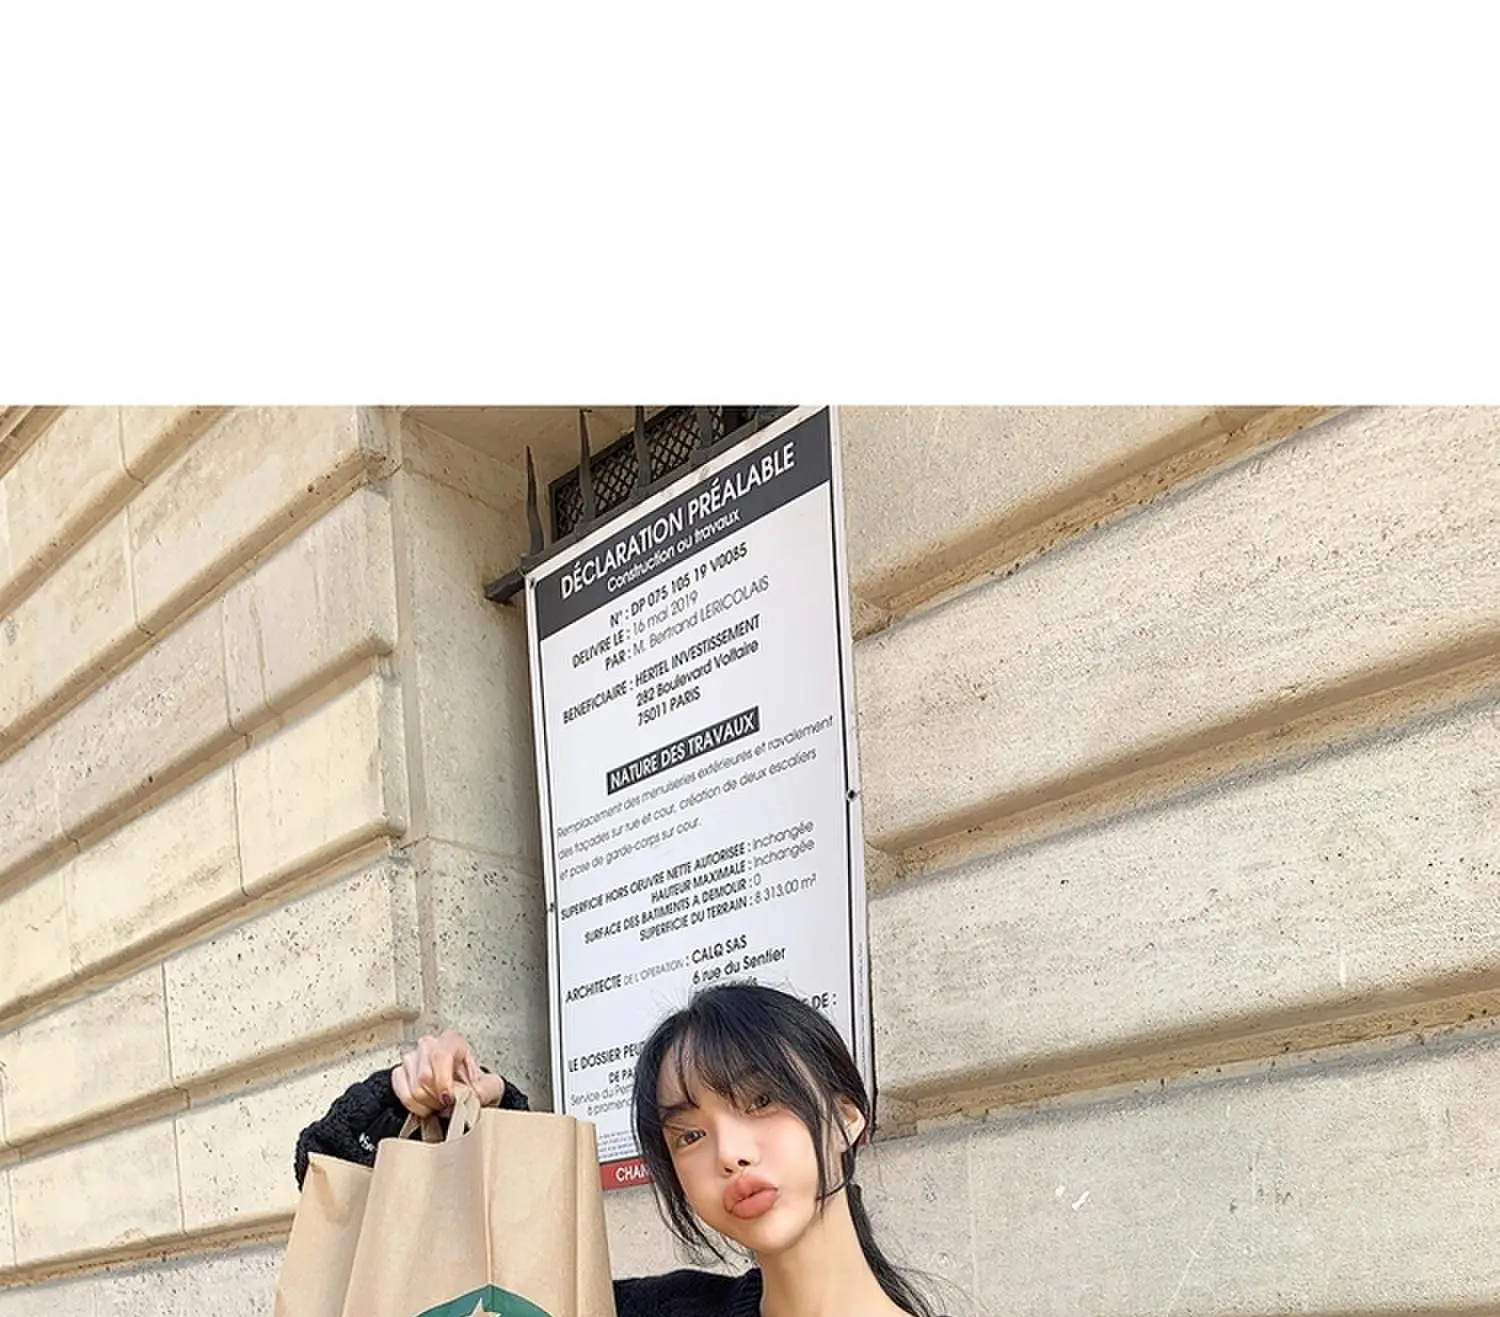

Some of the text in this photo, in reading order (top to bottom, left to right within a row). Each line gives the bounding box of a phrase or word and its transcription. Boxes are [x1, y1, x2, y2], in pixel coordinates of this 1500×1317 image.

[561, 439, 795, 600] DÉCLARATION PRÉALABLE
[606, 508, 741, 594] Construction ou travaux
[612, 627, 625, 646] LE
[632, 616, 645, 636] 16
[646, 605, 668, 628] mai
[670, 587, 698, 615] 2019
[630, 596, 646, 617] DP
[647, 583, 668, 608] 075
[670, 571, 690, 595] 105
[694, 562, 707, 582] 19
[604, 647, 626, 671] PAR
[648, 609, 698, 648] Bertrand
[699, 572, 769, 622] LERICOLAIS
[562, 679, 627, 724] BENEFICIAIRE
[634, 658, 669, 689] HERTEL
[670, 612, 761, 671] INVESTISSEMENT
[656, 657, 712, 698] Boulevard
[713, 636, 759, 670] Voltaire
[636, 684, 701, 727] 75011 PARIS
[555, 713, 833, 838] Remplacement des menuiseries extérieures et ravalement
[609, 710, 755, 790] NATURE DES TRAVAUX
[557, 844, 573, 860] des
[573, 829, 610, 854] façades
[611, 824, 624, 839] sur
[624, 817, 640, 833] rue
[641, 812, 652, 827] et
[678, 784, 721, 812] création
[721, 777, 737, 795] de
[738, 765, 767, 788] deux
[767, 745, 817, 776] escaliers
[558, 867, 568, 881] et
[569, 858, 591, 879] pose
[591, 853, 604, 868] de
[605, 830, 660, 865] garde-corps
[660, 825, 674, 841] sur
[560, 893, 603, 921] SUPERFICIE
[604, 884, 629, 904] HORS
[666, 860, 692, 882] NETTE
[693, 840, 745, 872] AUTORISEE
[649, 878, 690, 904] HAUTEUR
[692, 858, 746, 889] MAXIMALE
[584, 920, 622, 944] SURFACE
[623, 914, 640, 931] DES
[640, 896, 690, 925] BATIMENTS
[690, 892, 701, 907] A
[638, 913, 689, 942] SUPERFICIE
[690, 908, 705, 925] DU
[706, 893, 748, 919] TERRAIN
[564, 973, 622, 1004] ARCHITECTE
[690, 941, 723, 965] CALQ
[724, 933, 748, 954] SAS
[691, 969, 701, 985] 6
[702, 965, 721, 982] rue
[723, 957, 741, 976] du
[742, 944, 786, 971] Sentier
[567, 1057, 579, 1073] LE
[579, 1045, 621, 1069] DOSSIER
[811, 990, 829, 1009] DE
[569, 1087, 600, 1106] Service
[600, 1083, 614, 1099] du
[607, 1069, 620, 1084] DE
